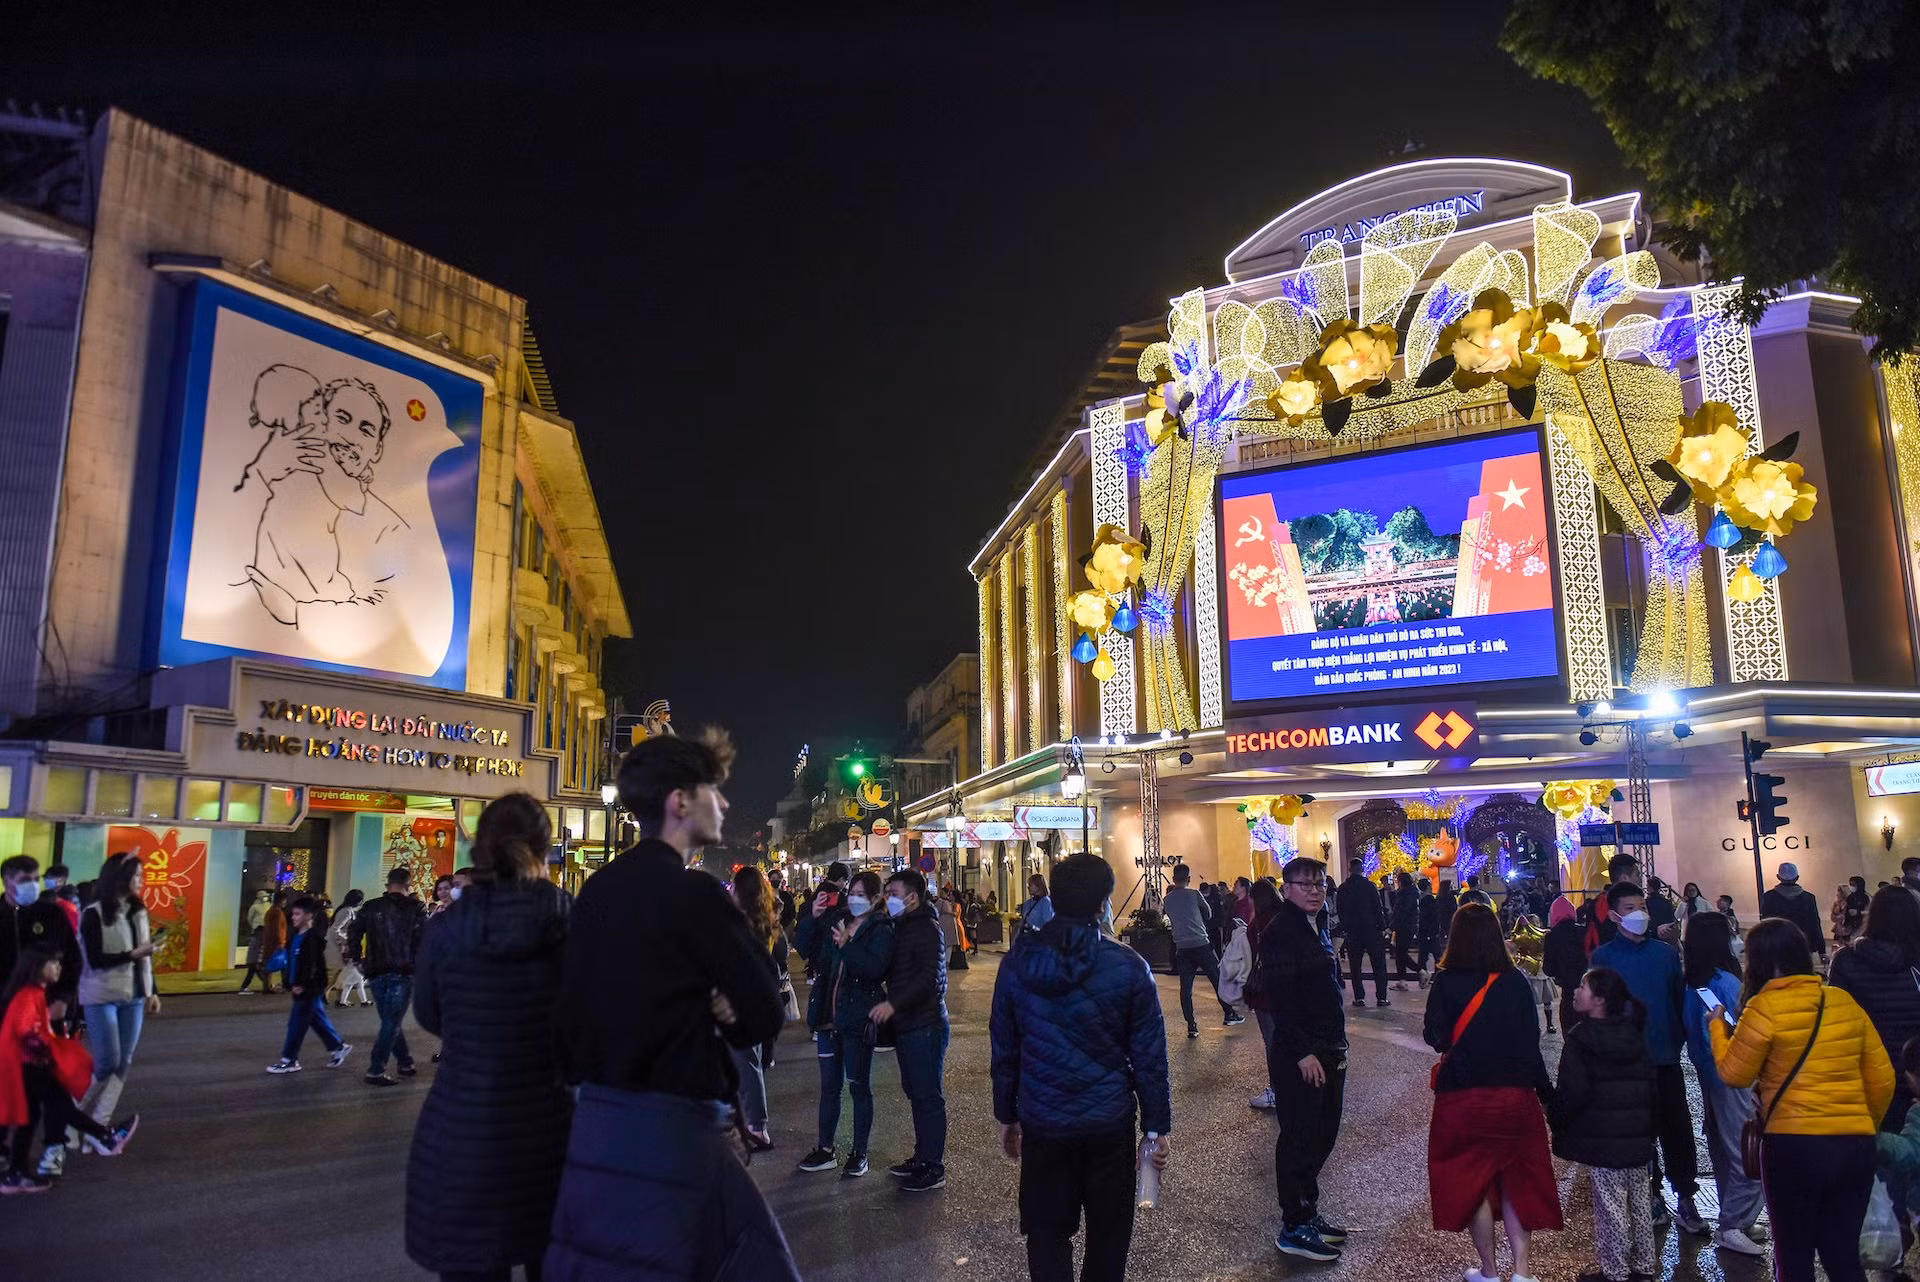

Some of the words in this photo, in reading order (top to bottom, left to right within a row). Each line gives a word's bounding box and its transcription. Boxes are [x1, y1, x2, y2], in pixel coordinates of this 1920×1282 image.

[1409, 630, 1419, 641] RA
[1435, 627, 1447, 638] THI
[1408, 646, 1427, 659] PHÁT
[1448, 644, 1467, 655] KINH
[1392, 668, 1402, 679] AN
[1403, 667, 1421, 678] NINH
[1438, 663, 1457, 675] 2023
[490, 729, 510, 747] TA
[1226, 722, 1402, 753] TECHCOMBANK
[428, 751, 452, 769] TO
[1031, 815, 1049, 823] DOLCE
[1052, 815, 1080, 823] GABBANA
[1722, 836, 1810, 851] GUCCI
[1135, 855, 1183, 868] HLOT
